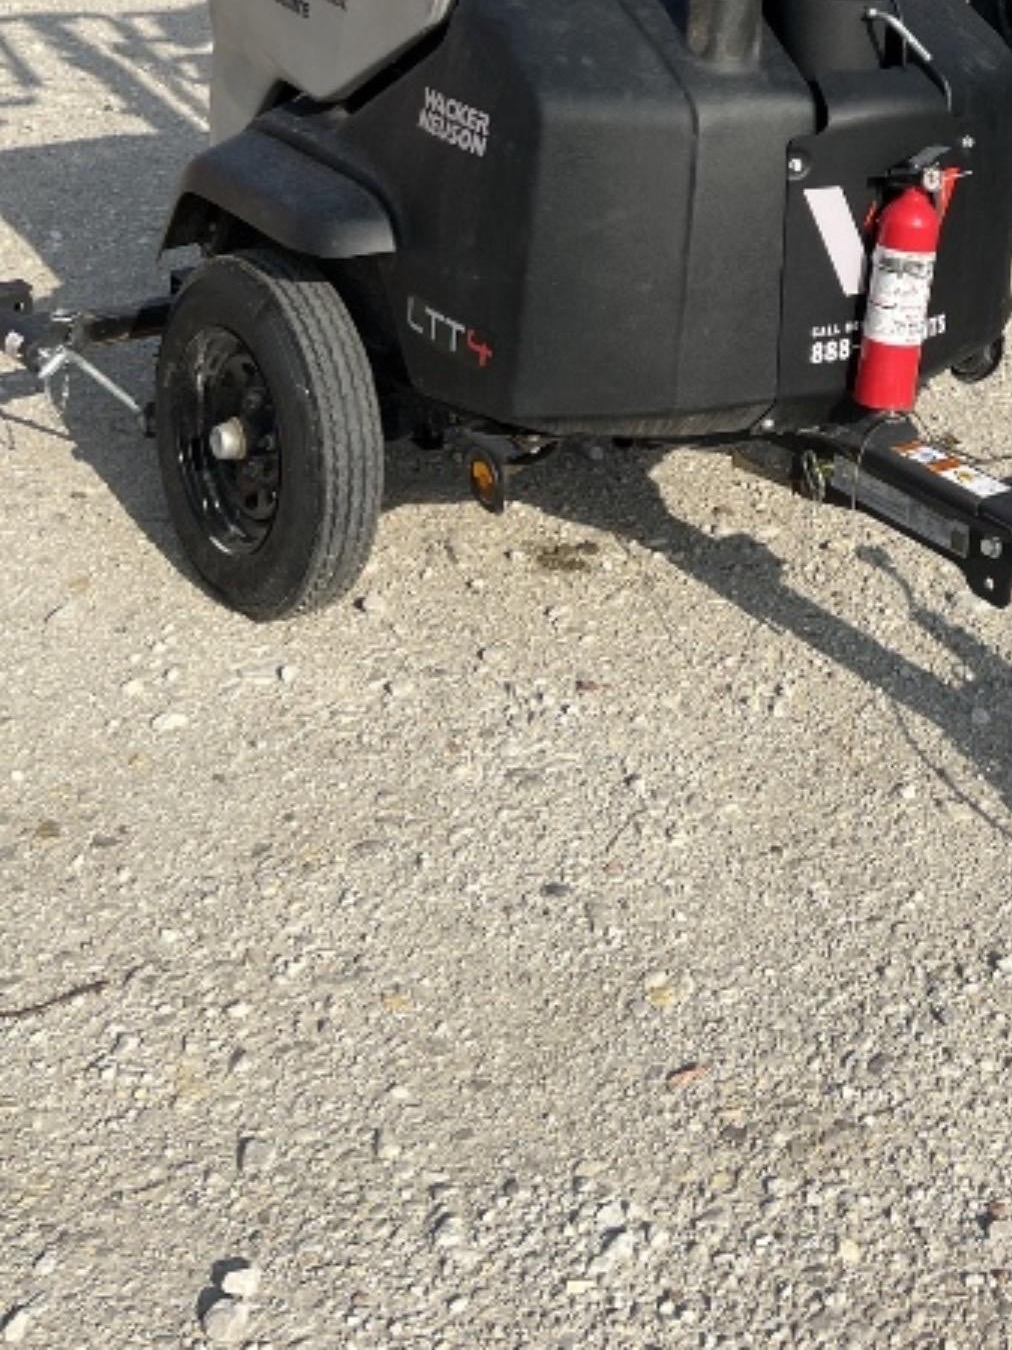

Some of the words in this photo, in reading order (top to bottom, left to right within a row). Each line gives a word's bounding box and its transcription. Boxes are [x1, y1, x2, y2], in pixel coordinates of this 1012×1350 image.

[417, 109, 487, 157] NEUSON
[424, 86, 490, 136] WACKER
[406, 296, 493, 368] LTT4
